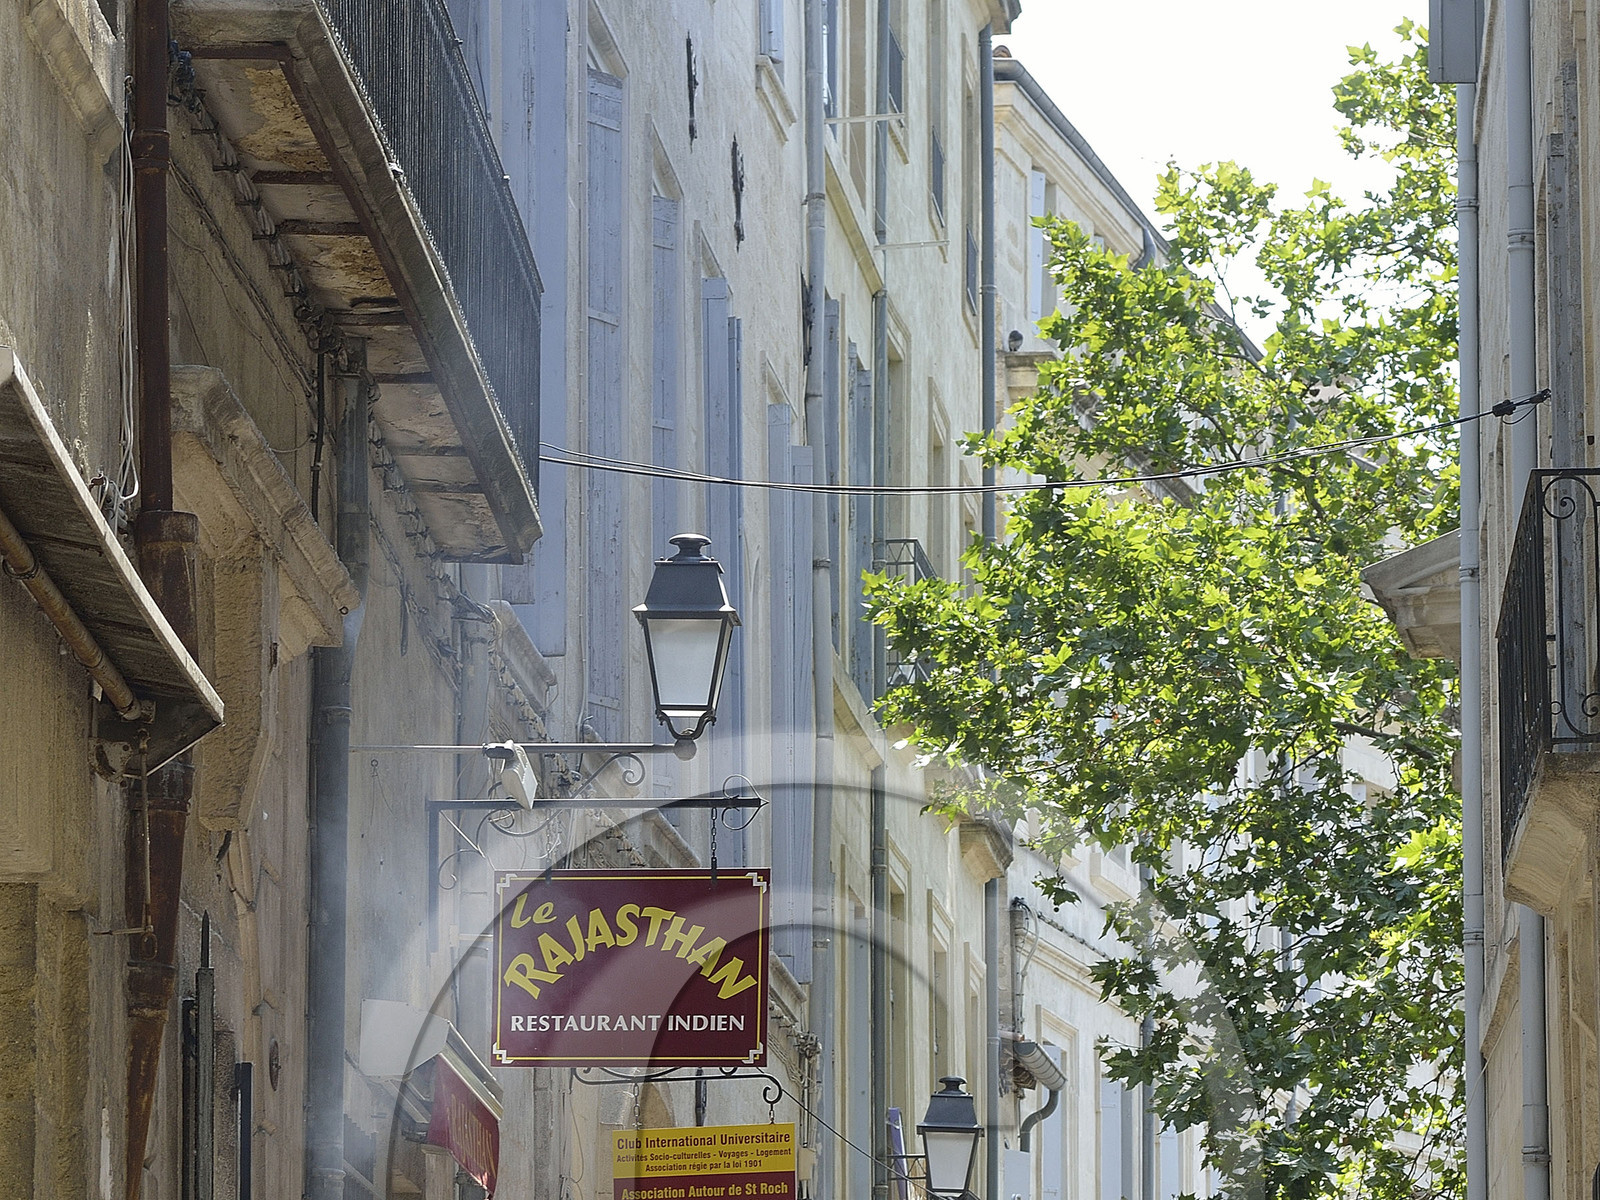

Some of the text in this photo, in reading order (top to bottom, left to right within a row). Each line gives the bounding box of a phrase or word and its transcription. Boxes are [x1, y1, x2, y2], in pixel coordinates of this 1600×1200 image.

[503, 903, 758, 1000] RAJASTHAN
[510, 1015, 745, 1032] RESTAURANT INDIEN
[617, 1132, 790, 1149] Club International Universitaire
[649, 1151, 711, 1161] Socio-culturelles
[718, 1150, 749, 1159] Voyages
[756, 1148, 792, 1157] Logement
[645, 1163, 687, 1172] Association
[709, 1162, 721, 1171] par
[732, 1160, 742, 1168] loi
[744, 1160, 762, 1168] 1901
[621, 1182, 788, 1200] Association Autour de St Roch
